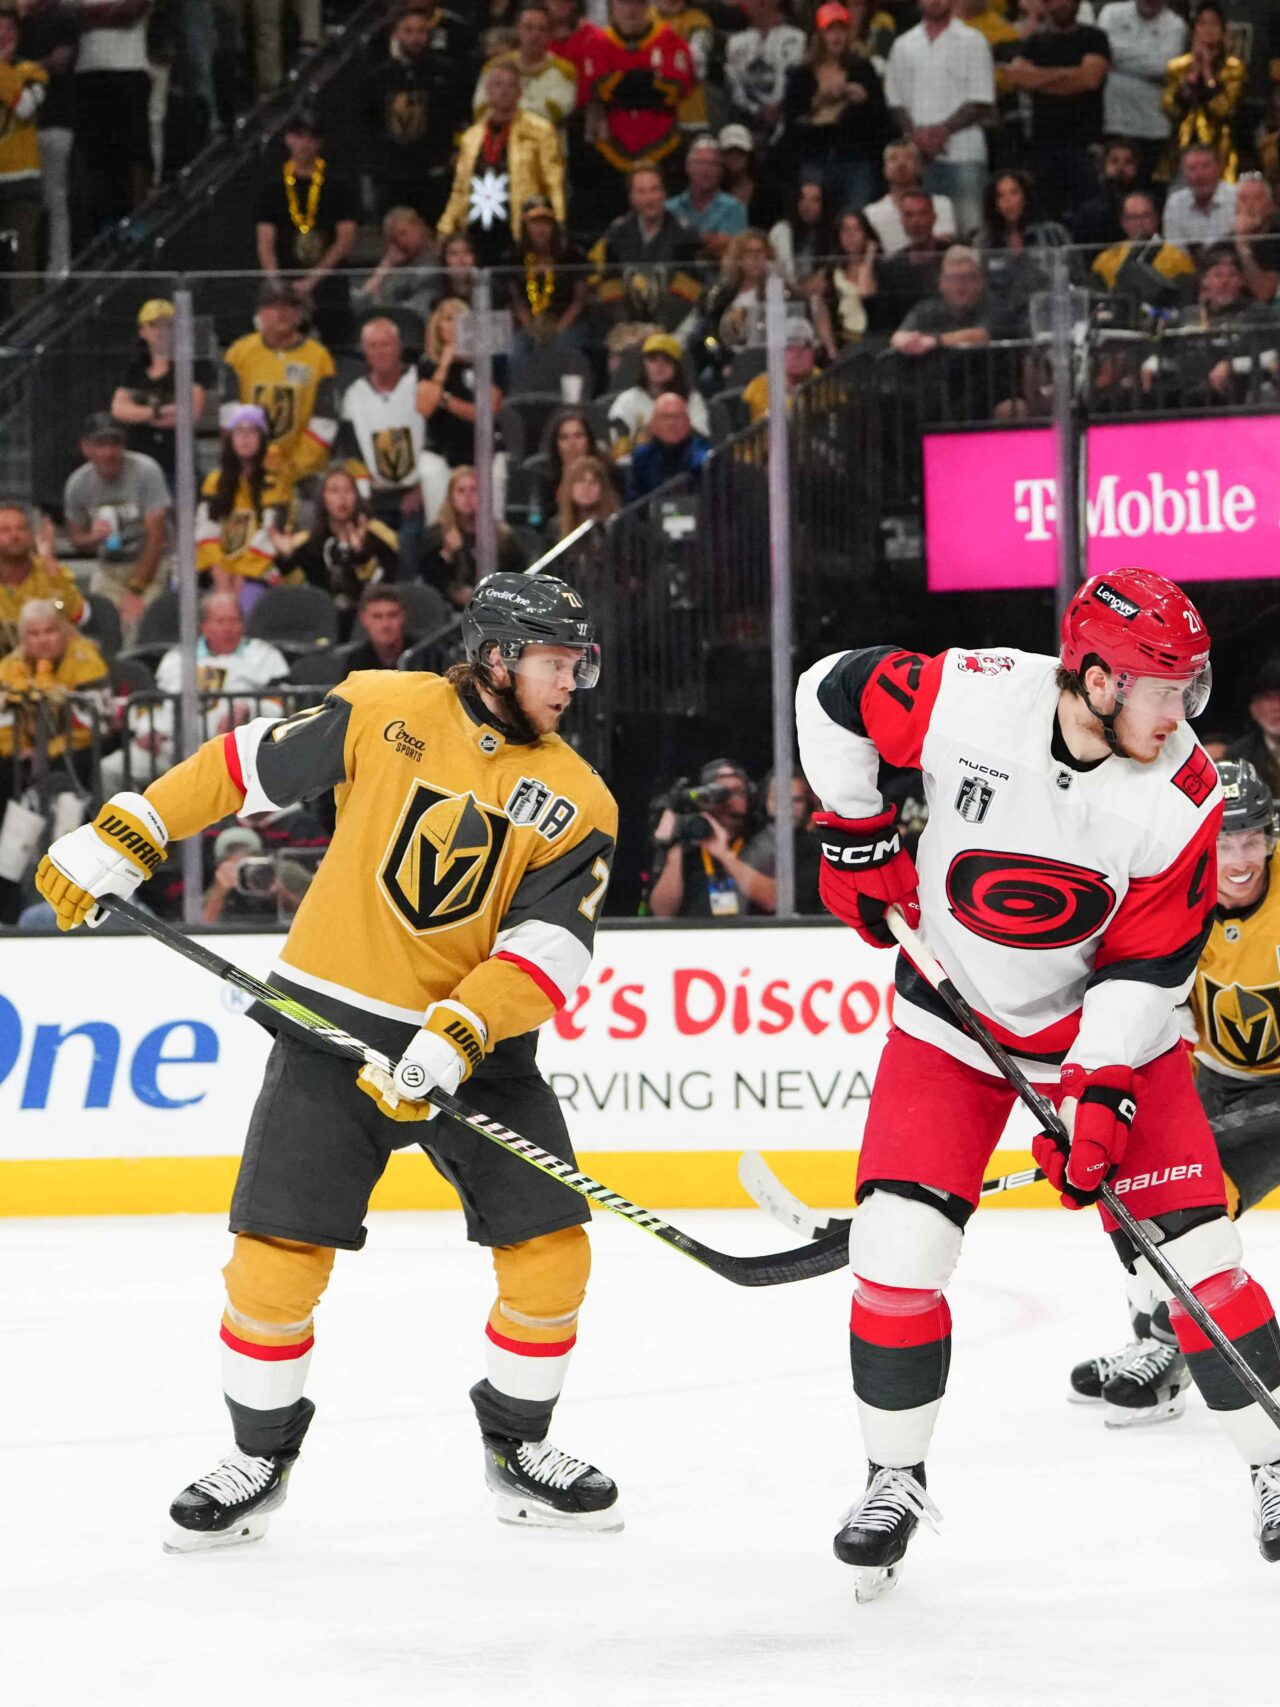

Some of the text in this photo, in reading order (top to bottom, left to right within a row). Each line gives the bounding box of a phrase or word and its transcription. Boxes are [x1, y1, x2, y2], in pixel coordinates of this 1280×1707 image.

[1095, 585, 1139, 618] Lenovo
[1182, 610, 1202, 635] 21
[383, 720, 427, 752] Circa
[395, 742, 423, 764] SPORTS
[958, 757, 1010, 782] NUCOR
[537, 796, 578, 843] A
[821, 832, 900, 864] CCM
[907, 901, 921, 911] CC
[672, 967, 896, 1036] Disco
